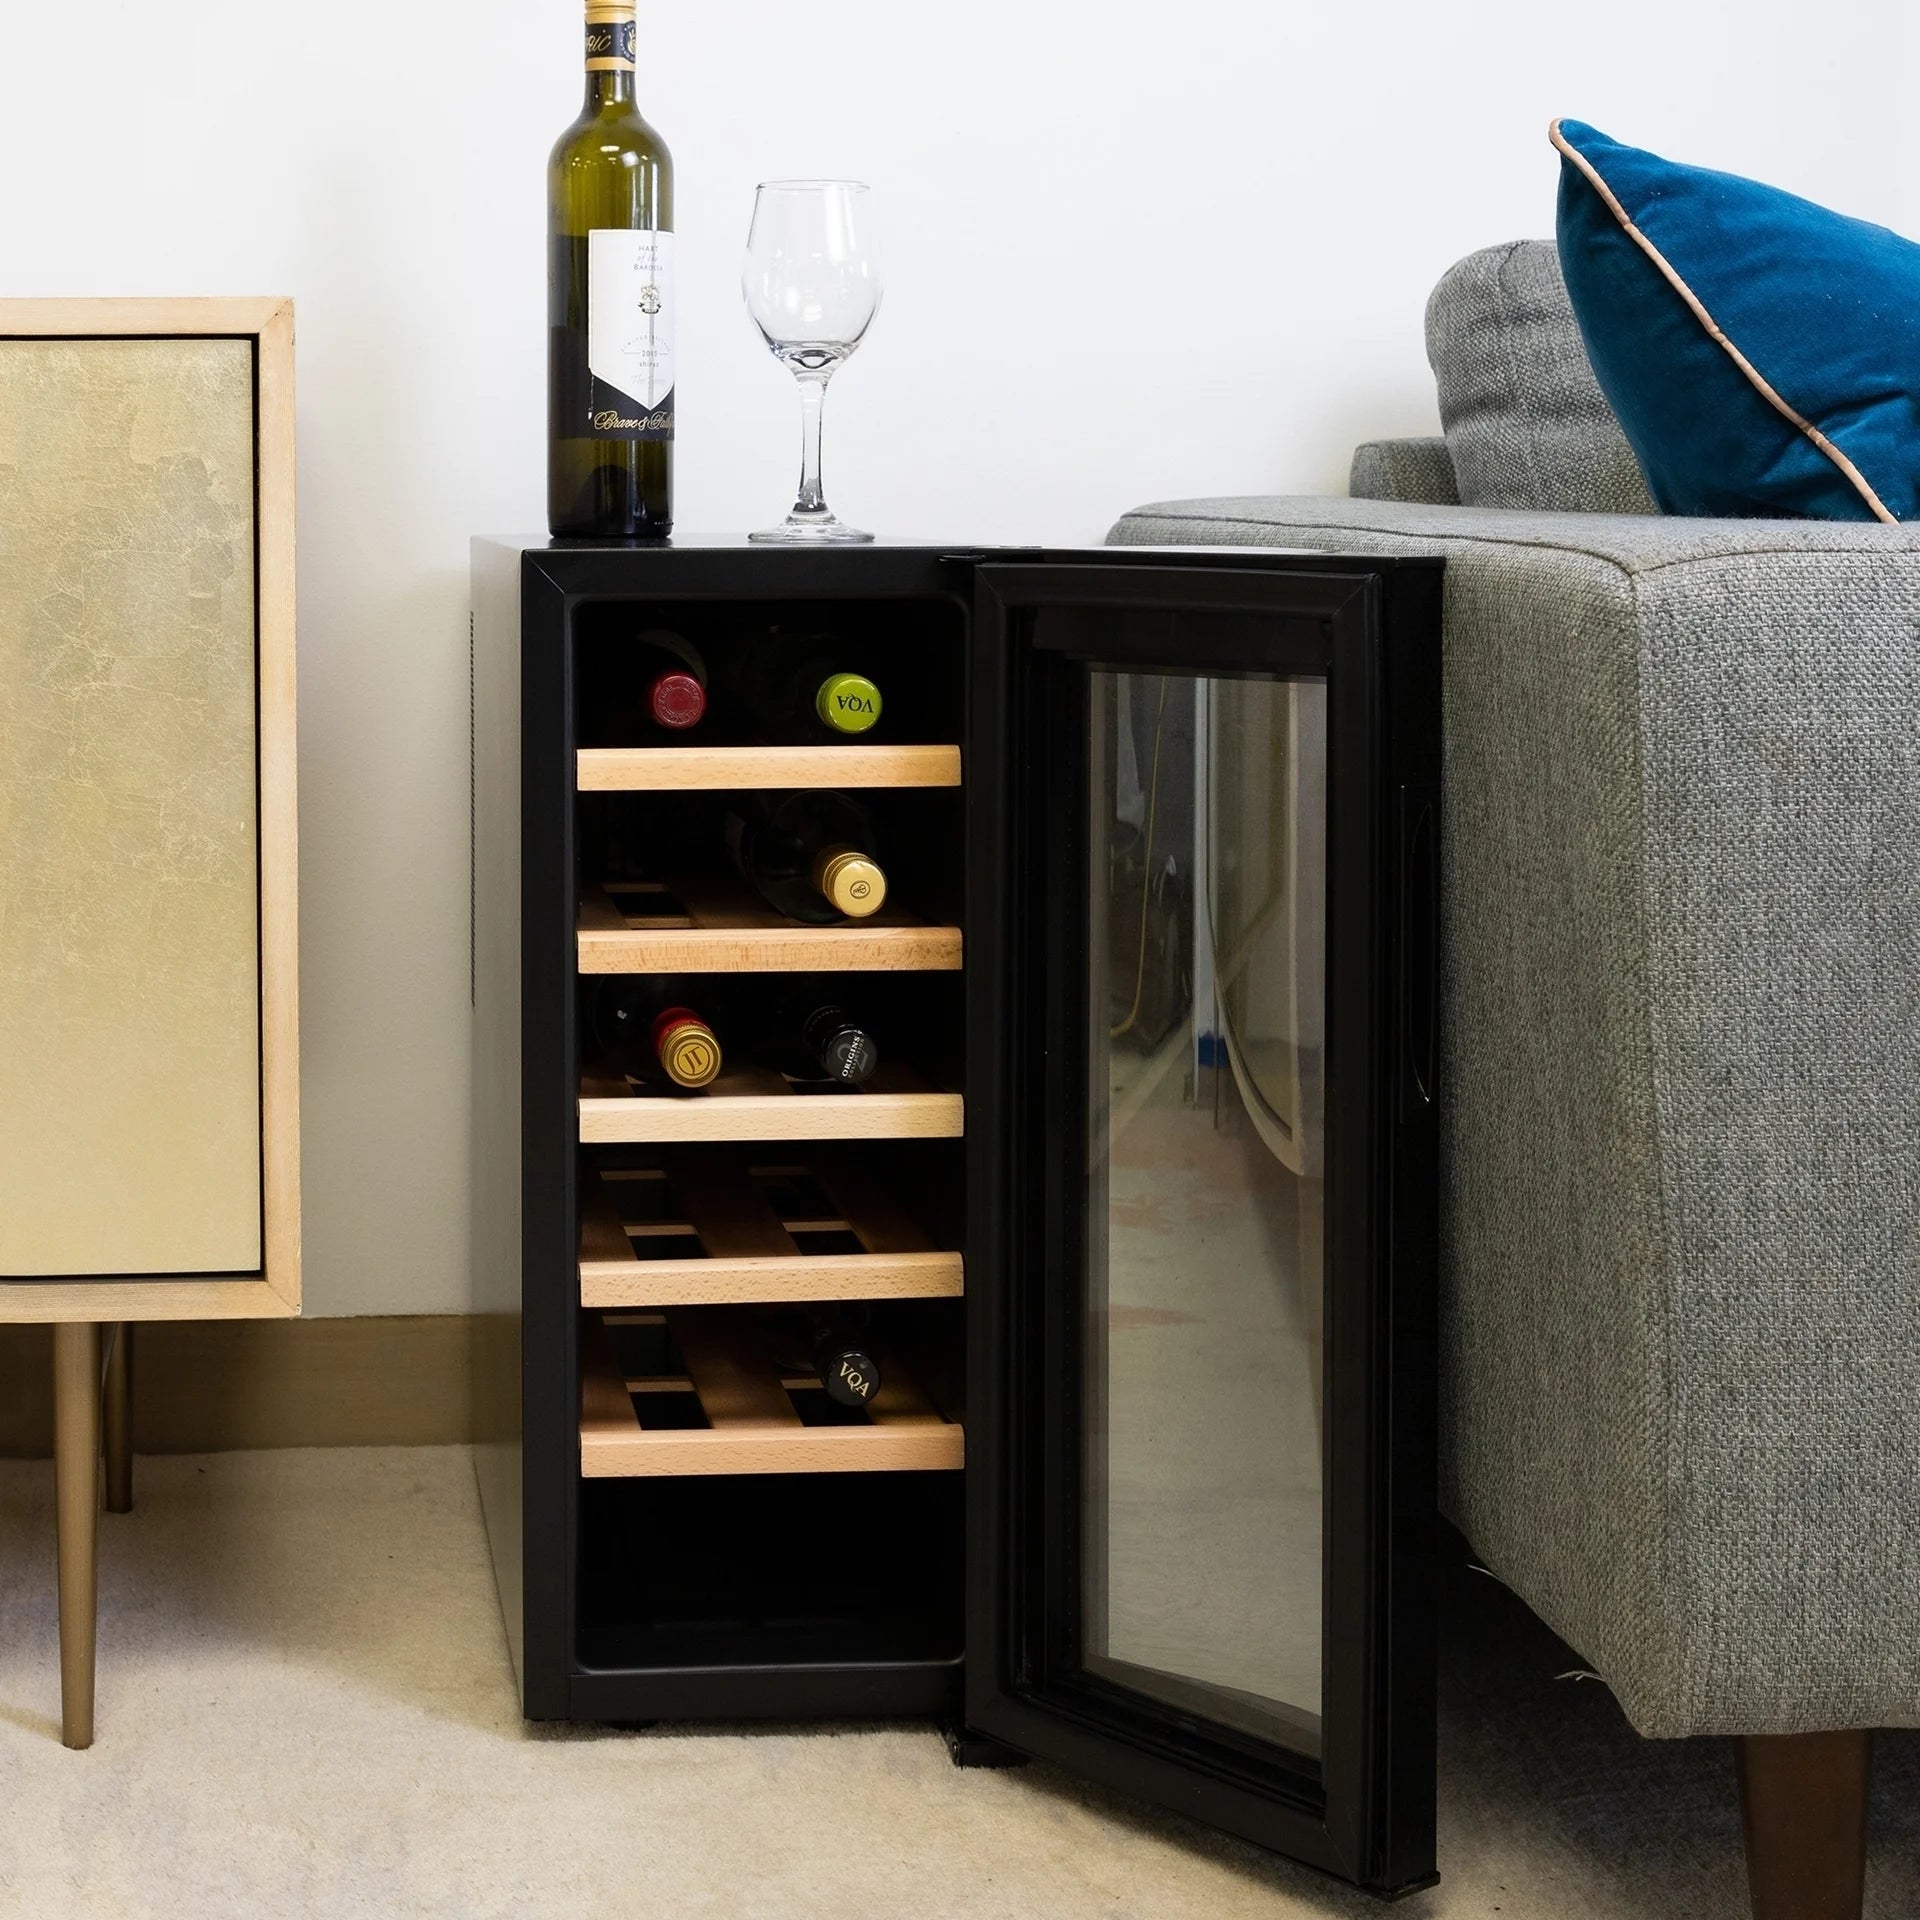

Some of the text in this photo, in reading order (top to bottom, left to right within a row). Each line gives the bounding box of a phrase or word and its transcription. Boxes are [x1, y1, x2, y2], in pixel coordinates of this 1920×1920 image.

[593, 410, 638, 430] Brave
[638, 416, 648, 431] &
[836, 691, 875, 713] VQA
[841, 1035, 860, 1077] ORIGINS
[840, 1361, 870, 1397] VQA
